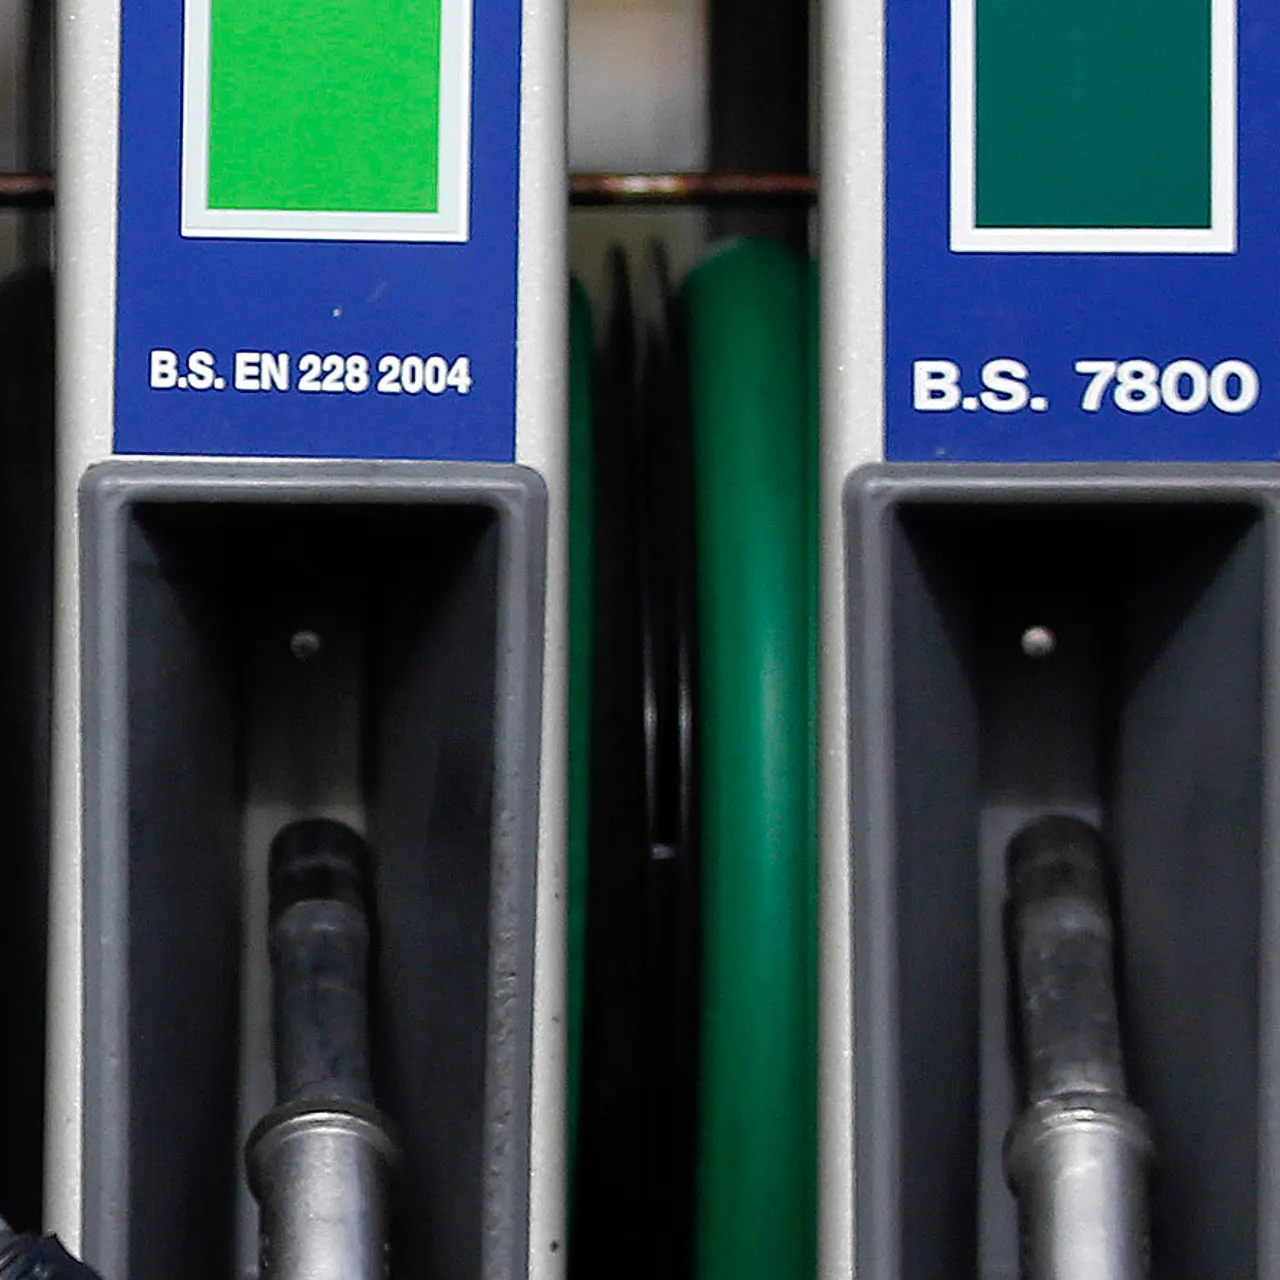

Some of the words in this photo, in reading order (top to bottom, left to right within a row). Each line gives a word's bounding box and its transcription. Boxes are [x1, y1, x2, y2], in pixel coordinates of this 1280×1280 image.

[149, 349, 225, 390] B.S.
[234, 351, 290, 392] EN
[297, 354, 369, 393] 228
[376, 355, 472, 394] 2004
[912, 358, 1049, 413] B.S.
[1073, 358, 1261, 413] 7800
